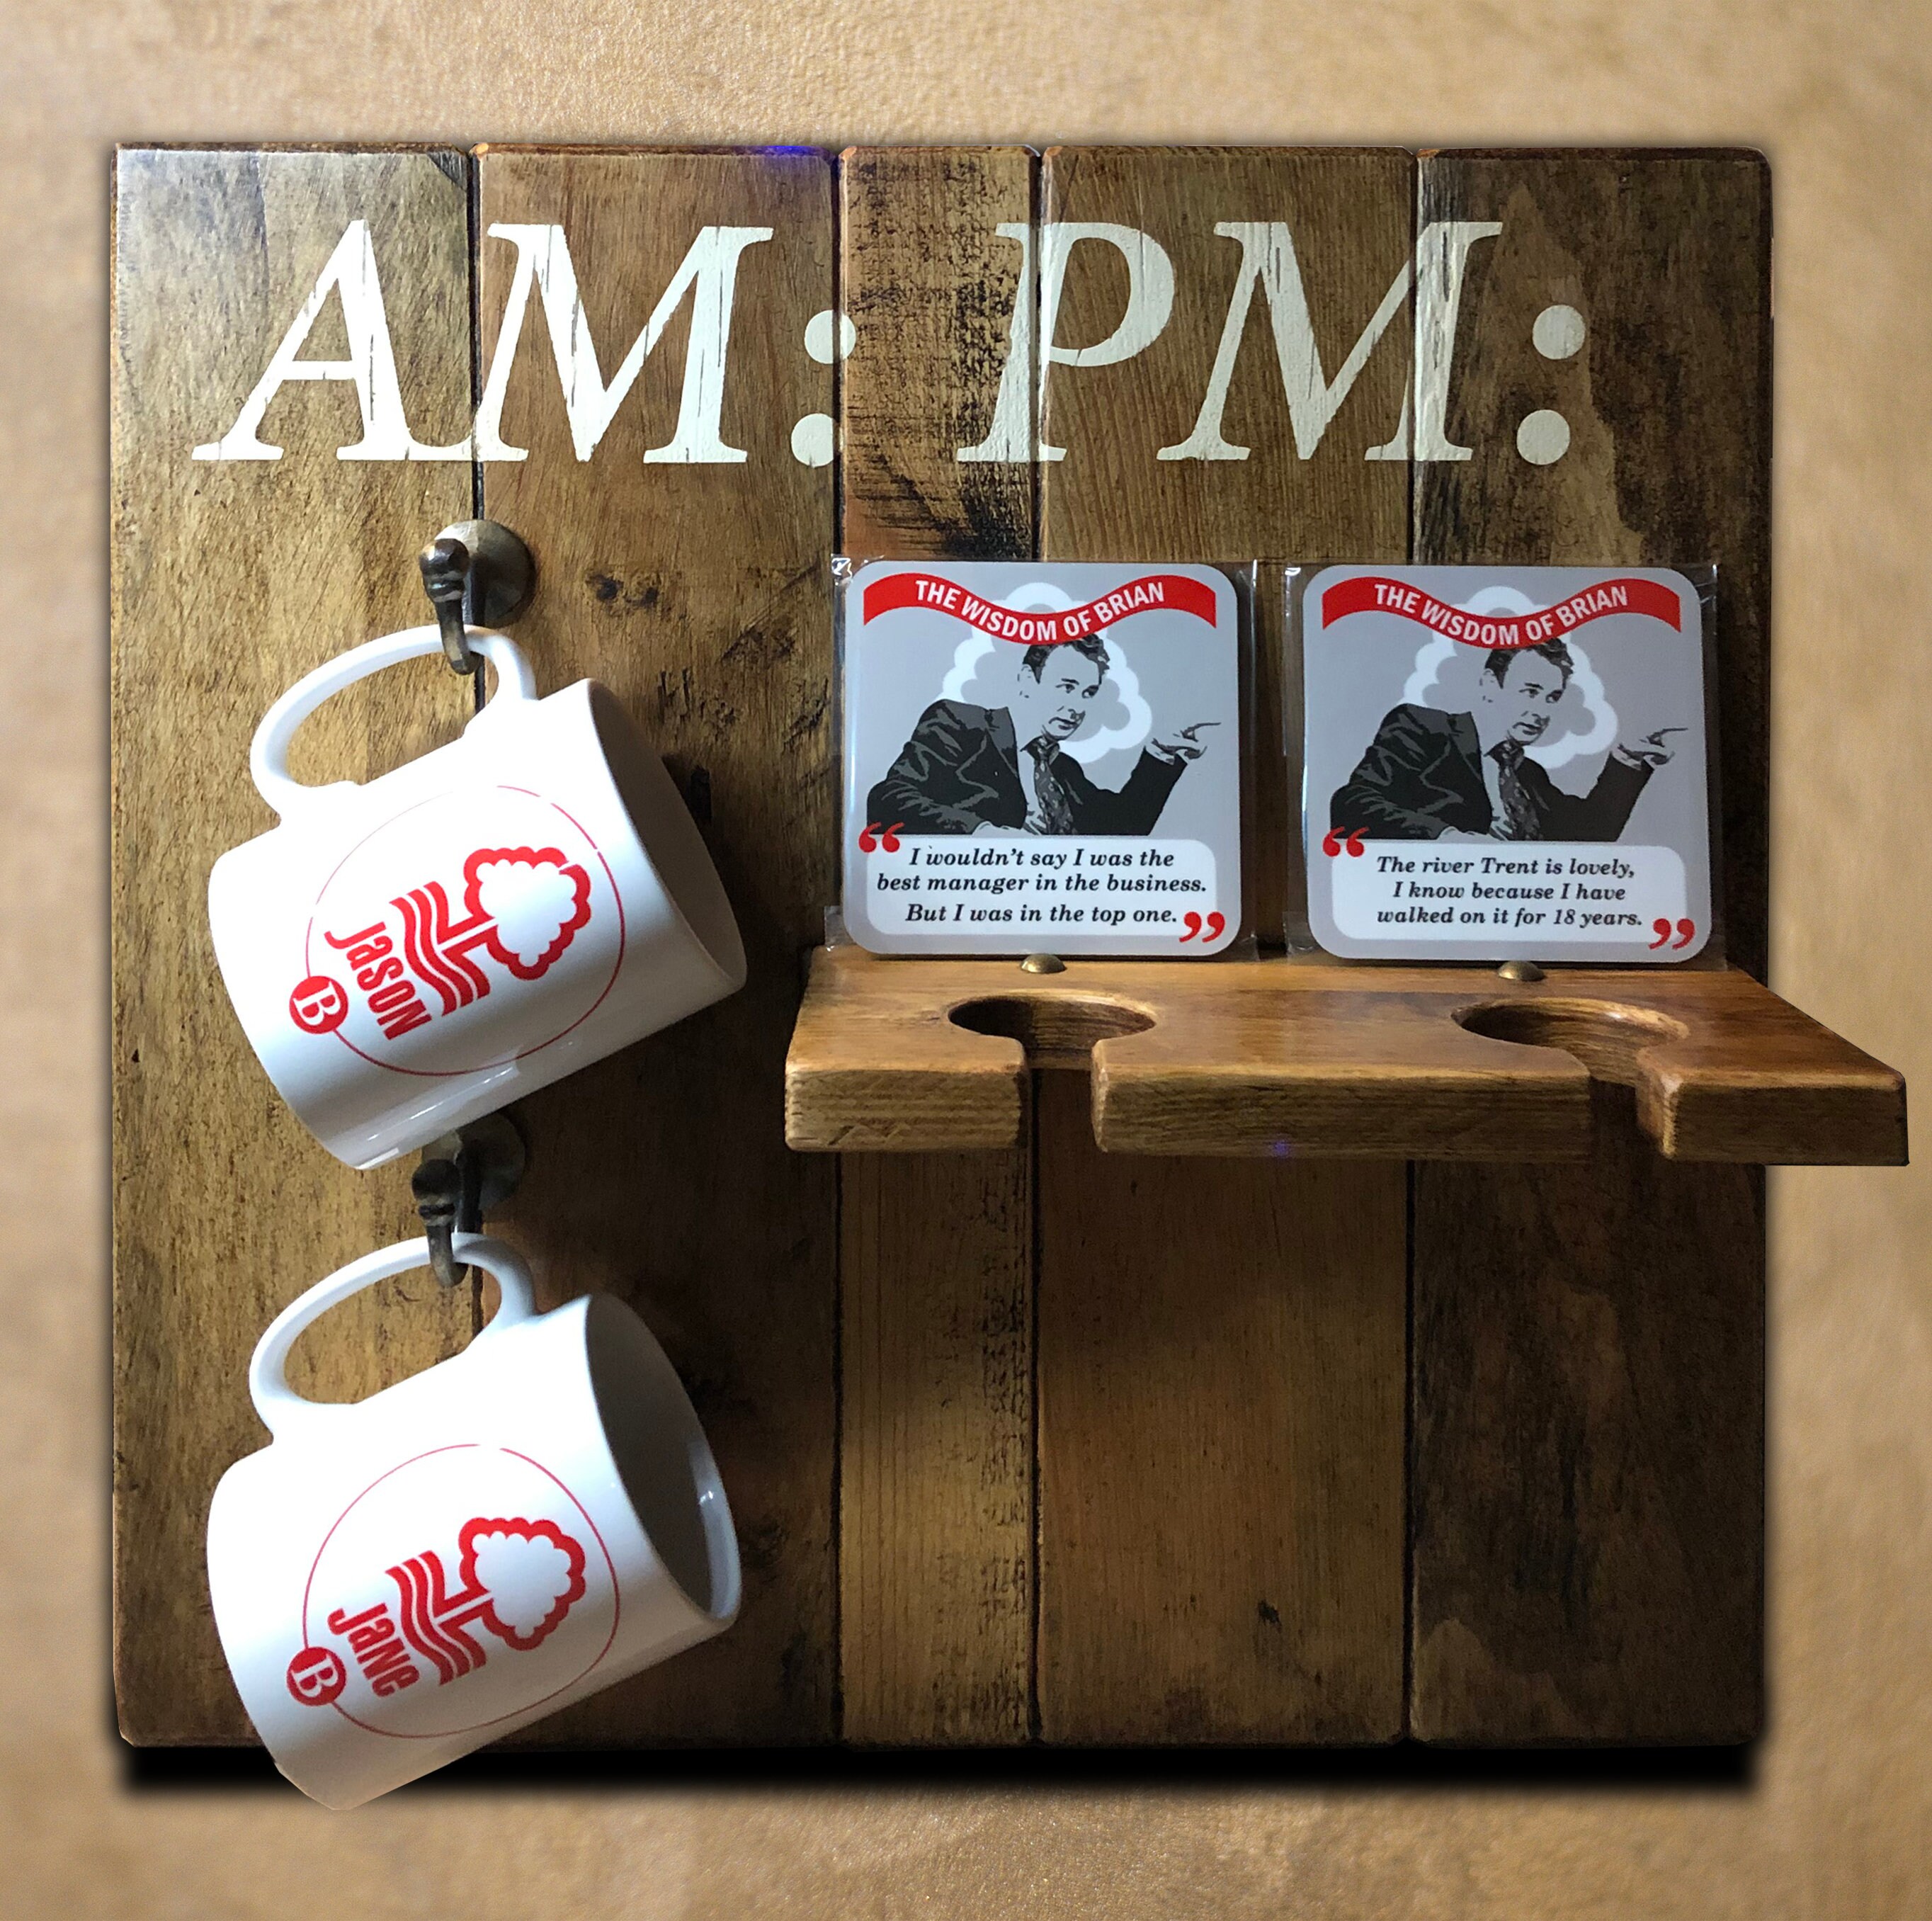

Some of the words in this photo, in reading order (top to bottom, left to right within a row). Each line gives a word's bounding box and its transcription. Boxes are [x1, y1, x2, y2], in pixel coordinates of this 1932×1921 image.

[191, 219, 856, 468] AM:
[956, 221, 1586, 465] PM:
[916, 579, 964, 609] THE
[962, 600, 1057, 640] WISDOM
[1064, 611, 1092, 637] OF
[1096, 582, 1164, 624] BRIAN
[1375, 584, 1421, 613] THE
[1421, 603, 1518, 645] WISDOM
[1525, 616, 1555, 640] OF
[1560, 586, 1628, 628] BRIAN
[909, 848, 921, 866] I
[926, 848, 1024, 866] wouldn’t
[1030, 854, 1067, 870] say
[1073, 849, 1084, 866] I
[1090, 854, 1132, 866] was
[1140, 849, 1174, 866] the
[1377, 856, 1416, 873] The
[1422, 857, 1474, 873] river
[1481, 857, 1538, 874] Trent
[1545, 858, 1563, 875] is
[1569, 858, 1635, 879] lovely,
[877, 873, 921, 891] best
[928, 878, 1029, 895] manager
[1036, 873, 1057, 890] in
[1065, 873, 1100, 891] the
[1107, 873, 1206, 892] business.
[1393, 881, 1404, 897] I
[1409, 881, 1465, 899] know
[1472, 882, 1555, 900] because
[1561, 883, 1570, 900] I
[1576, 883, 1626, 900] have
[905, 903, 946, 922] But
[953, 904, 964, 922] I
[970, 909, 1013, 922] was
[1021, 904, 1042, 922] in
[1050, 904, 1084, 922] the
[1092, 907, 1126, 926] top
[1133, 910, 1176, 922] one.
[1377, 906, 1454, 924] walked
[1460, 912, 1486, 924] on
[1493, 907, 1508, 924] it
[1514, 907, 1547, 927] for
[1553, 909, 1576, 925] 18
[1579, 913, 1642, 929] years.
[292, 980, 341, 1026] B
[291, 1653, 339, 1697] B
